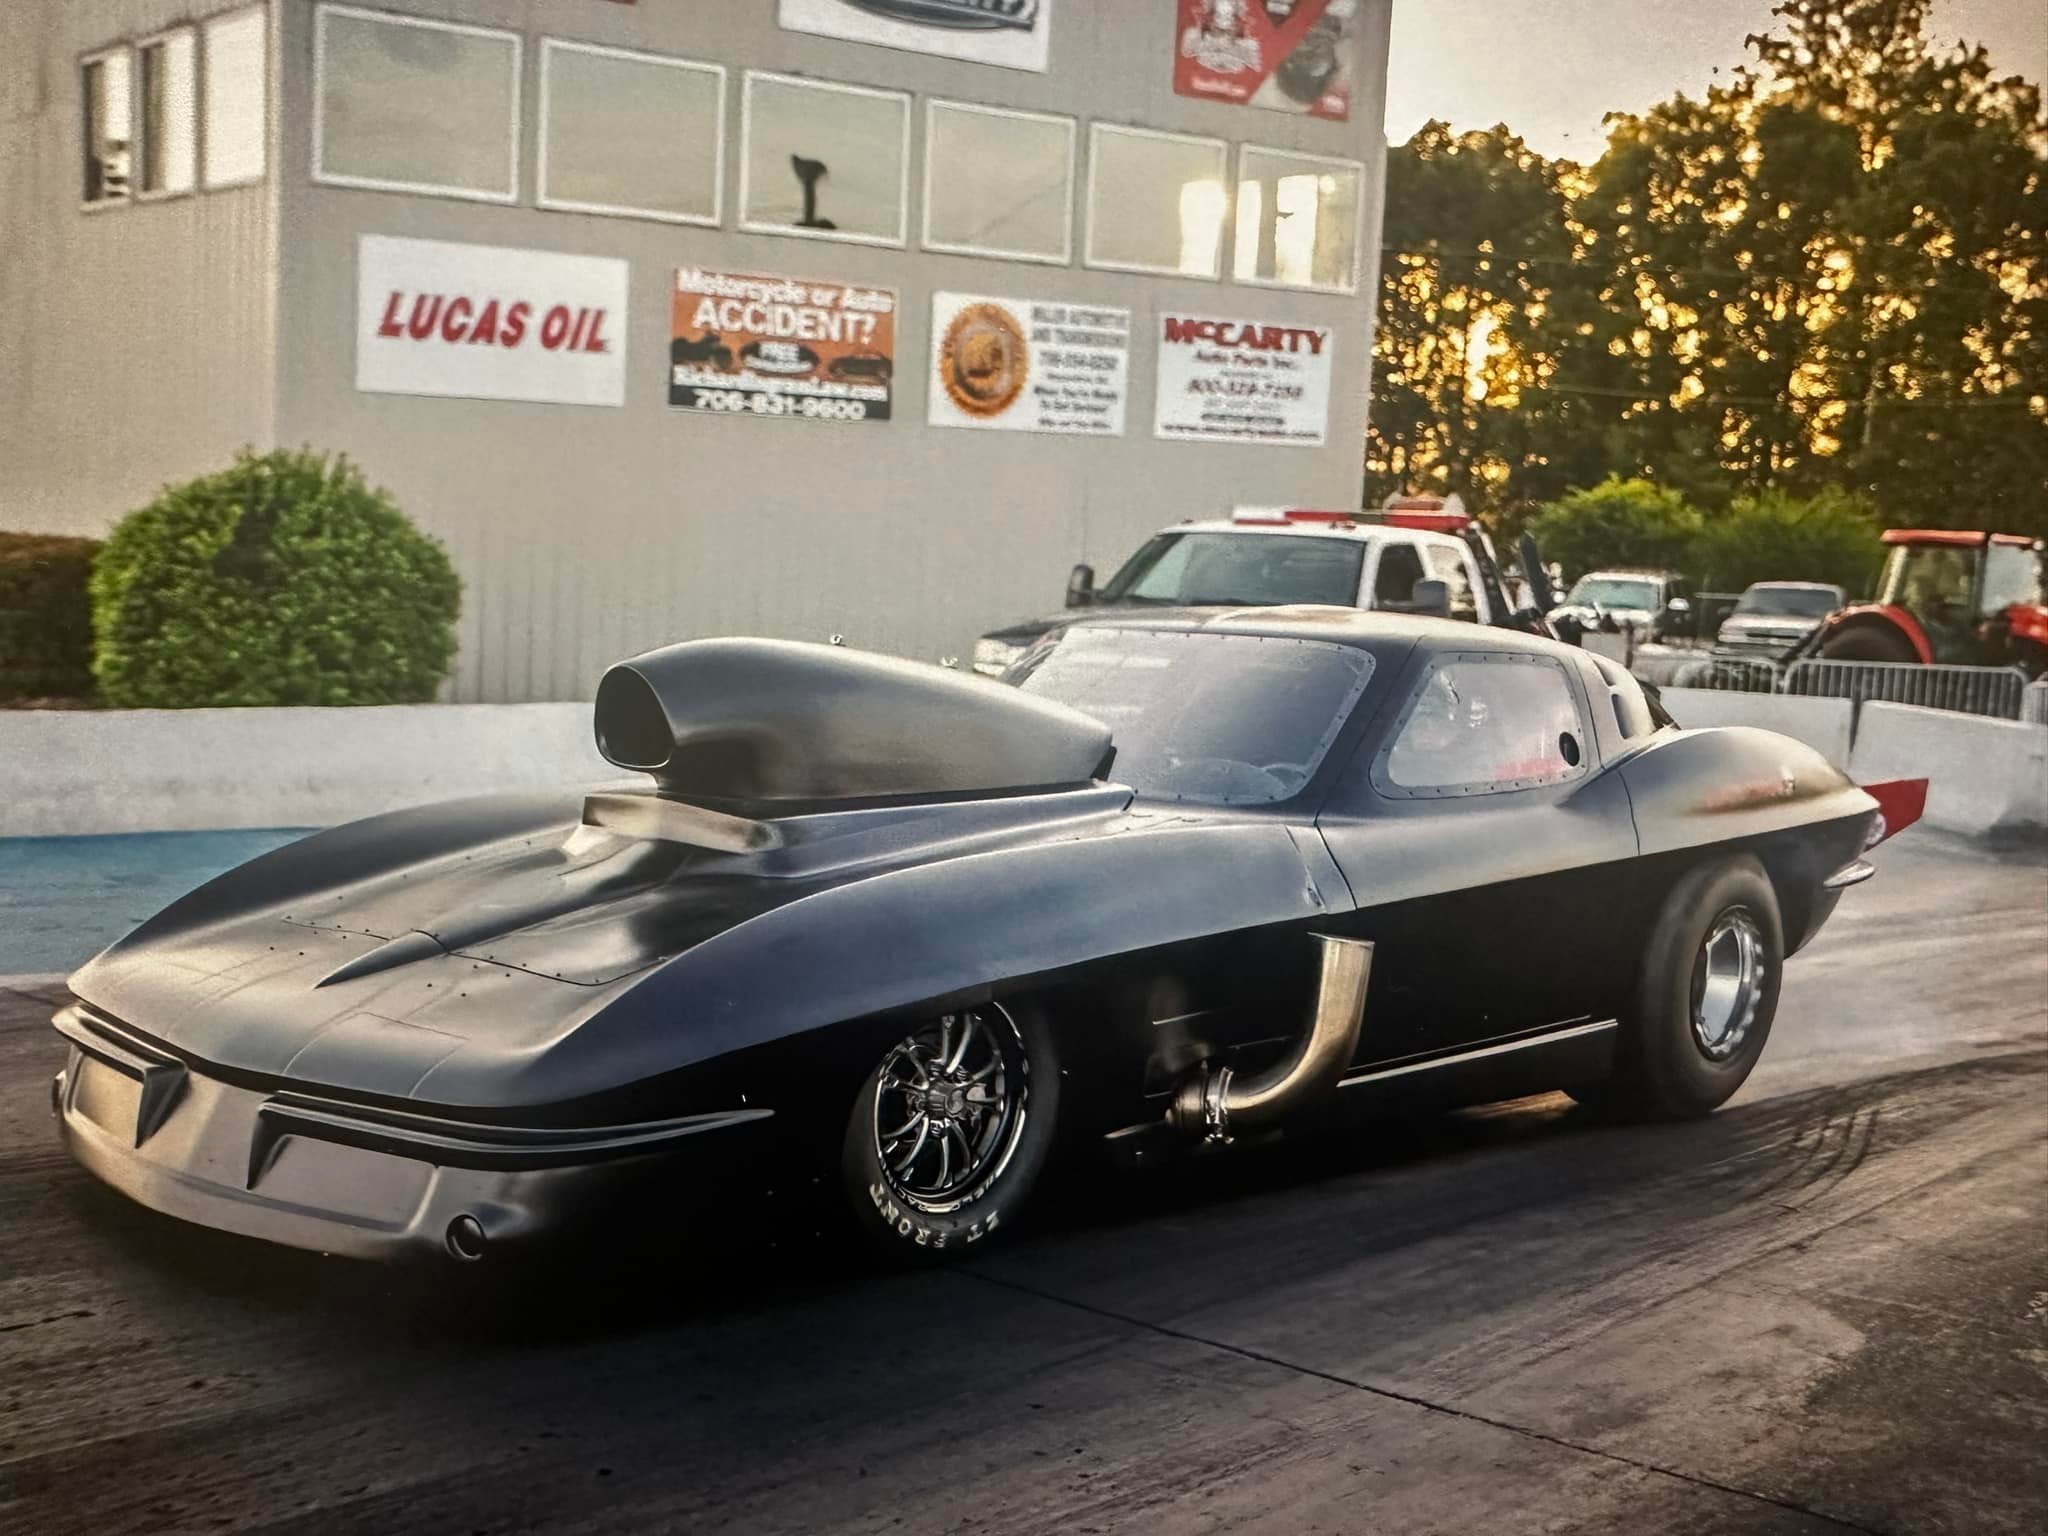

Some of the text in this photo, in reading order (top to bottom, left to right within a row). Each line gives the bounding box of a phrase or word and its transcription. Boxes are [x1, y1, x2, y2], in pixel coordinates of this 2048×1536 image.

[377, 291, 611, 354] LUCAS OIL
[692, 296, 877, 346] ACCIDENT?
[869, 1183, 947, 1248] FRONT
